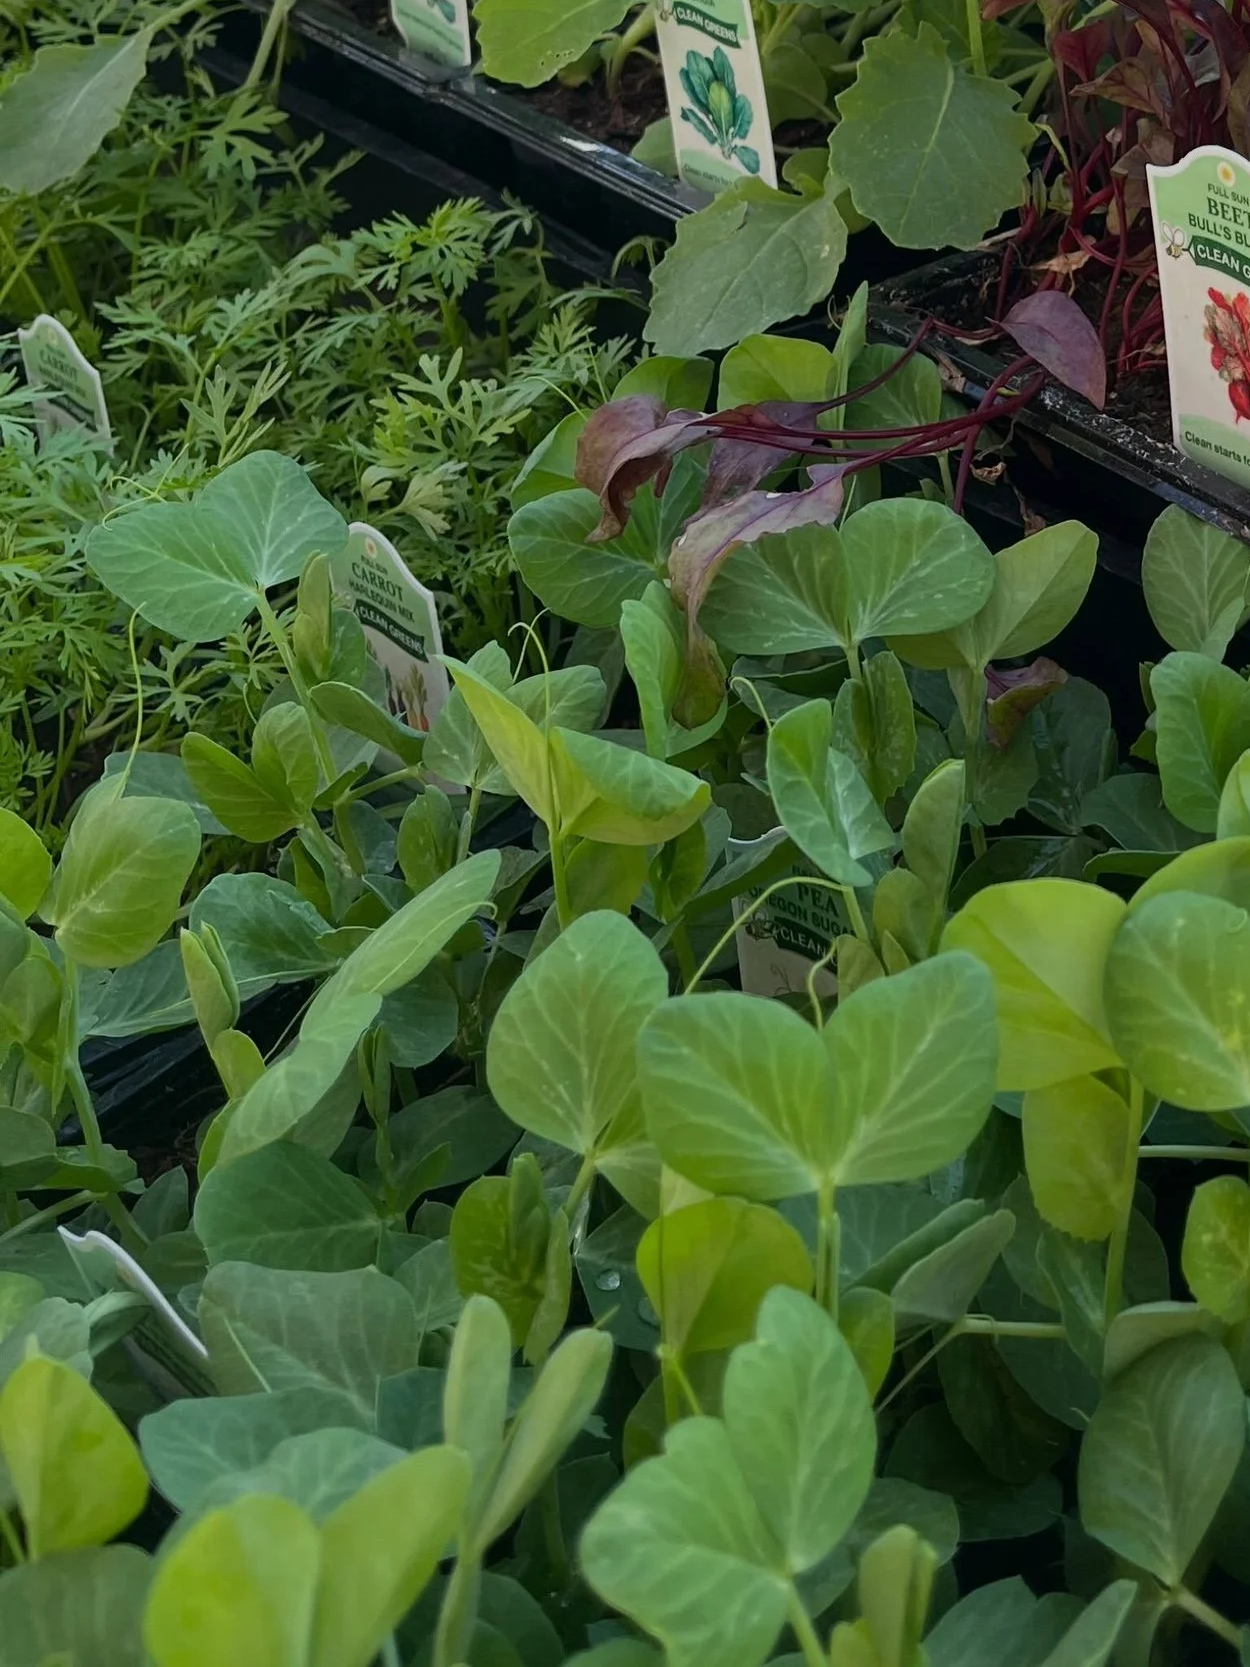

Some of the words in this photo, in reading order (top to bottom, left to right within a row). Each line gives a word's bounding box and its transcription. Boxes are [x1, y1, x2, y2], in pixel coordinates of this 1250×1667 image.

[677, 7, 703, 26] CLEAN
[704, 20, 737, 42] GREENS
[1207, 183, 1229, 199] FULL
[1231, 191, 1250, 206] SUN
[1188, 213, 1232, 241] BULL'S
[1196, 243, 1240, 273] CLEAN
[1185, 431, 1213, 450] Clean
[1214, 444, 1242, 463] starts
[352, 562, 403, 602] CARROT
[360, 606, 389, 631] CLEAN
[389, 624, 423, 654] GREENS
[797, 882, 839, 918] PEA
[780, 925, 827, 957] CLEAN
